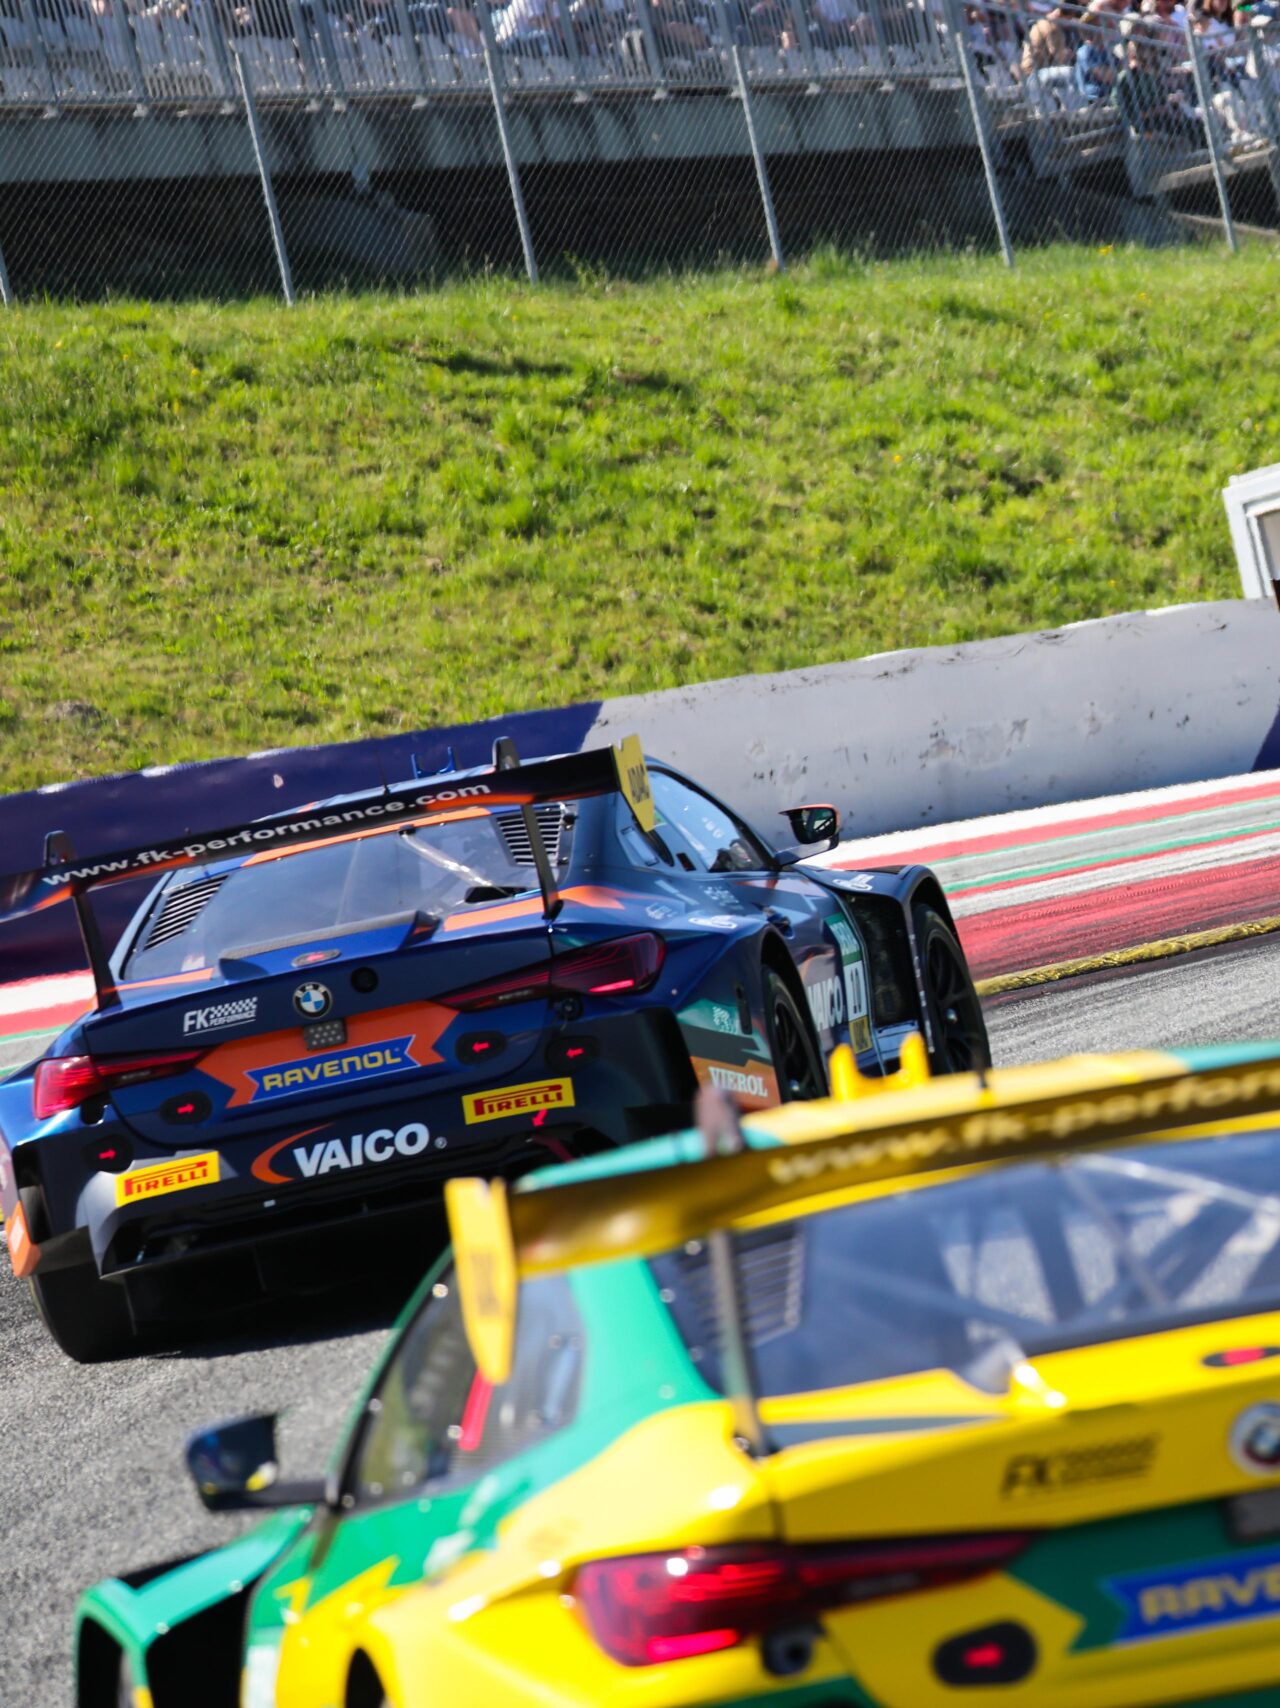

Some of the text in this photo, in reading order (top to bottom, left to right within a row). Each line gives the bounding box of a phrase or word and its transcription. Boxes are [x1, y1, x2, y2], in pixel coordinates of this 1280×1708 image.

[41, 781, 491, 887] www.fk-performance.com
[183, 1007, 211, 1033] FK
[262, 1049, 402, 1092] RAVENOL
[708, 1066, 769, 1098] VIEROL
[474, 1084, 563, 1117] PIRELLI
[293, 1122, 430, 1178] VAICO
[124, 1160, 208, 1197] PIRELLI
